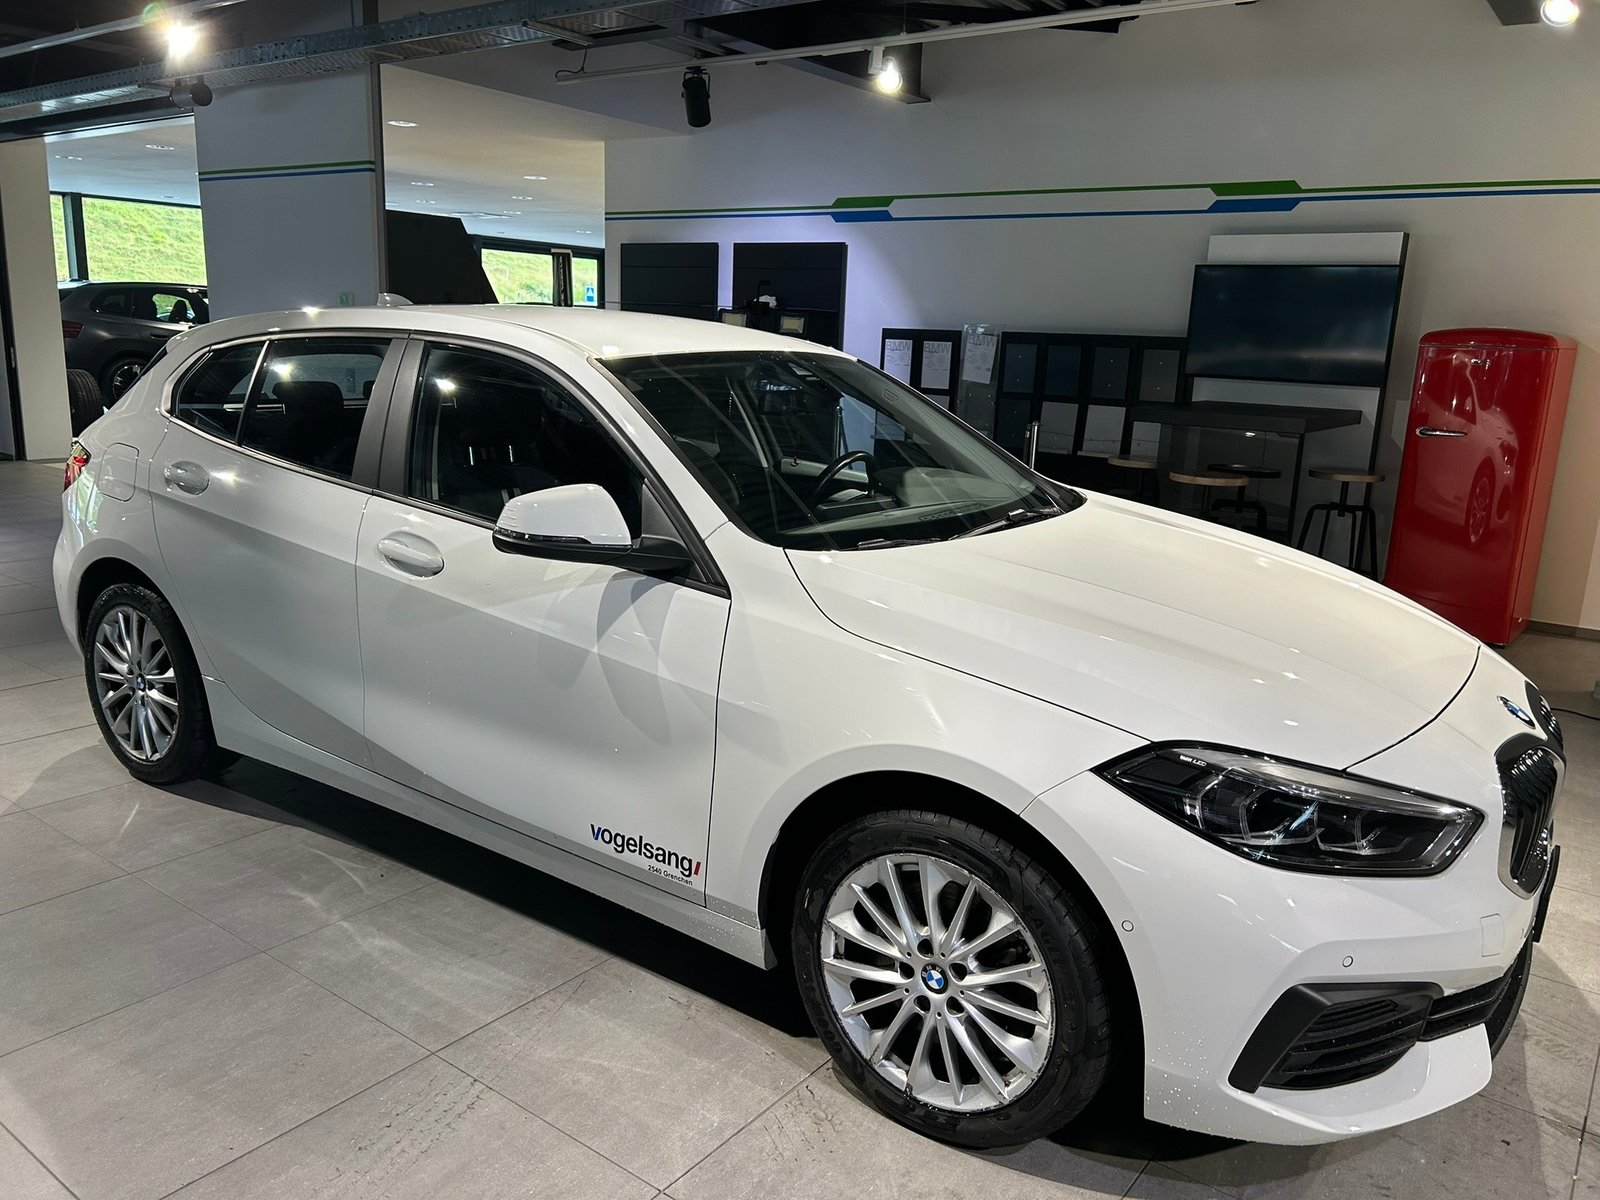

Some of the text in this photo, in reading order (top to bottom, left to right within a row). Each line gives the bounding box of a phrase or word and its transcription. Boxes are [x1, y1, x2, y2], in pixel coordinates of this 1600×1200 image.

[886, 341, 911, 351] BMW
[969, 335, 996, 347] BMW
[924, 343, 951, 353] BMW
[590, 823, 693, 878] vogelsang
[648, 864, 693, 886] 2540 Grenchen
